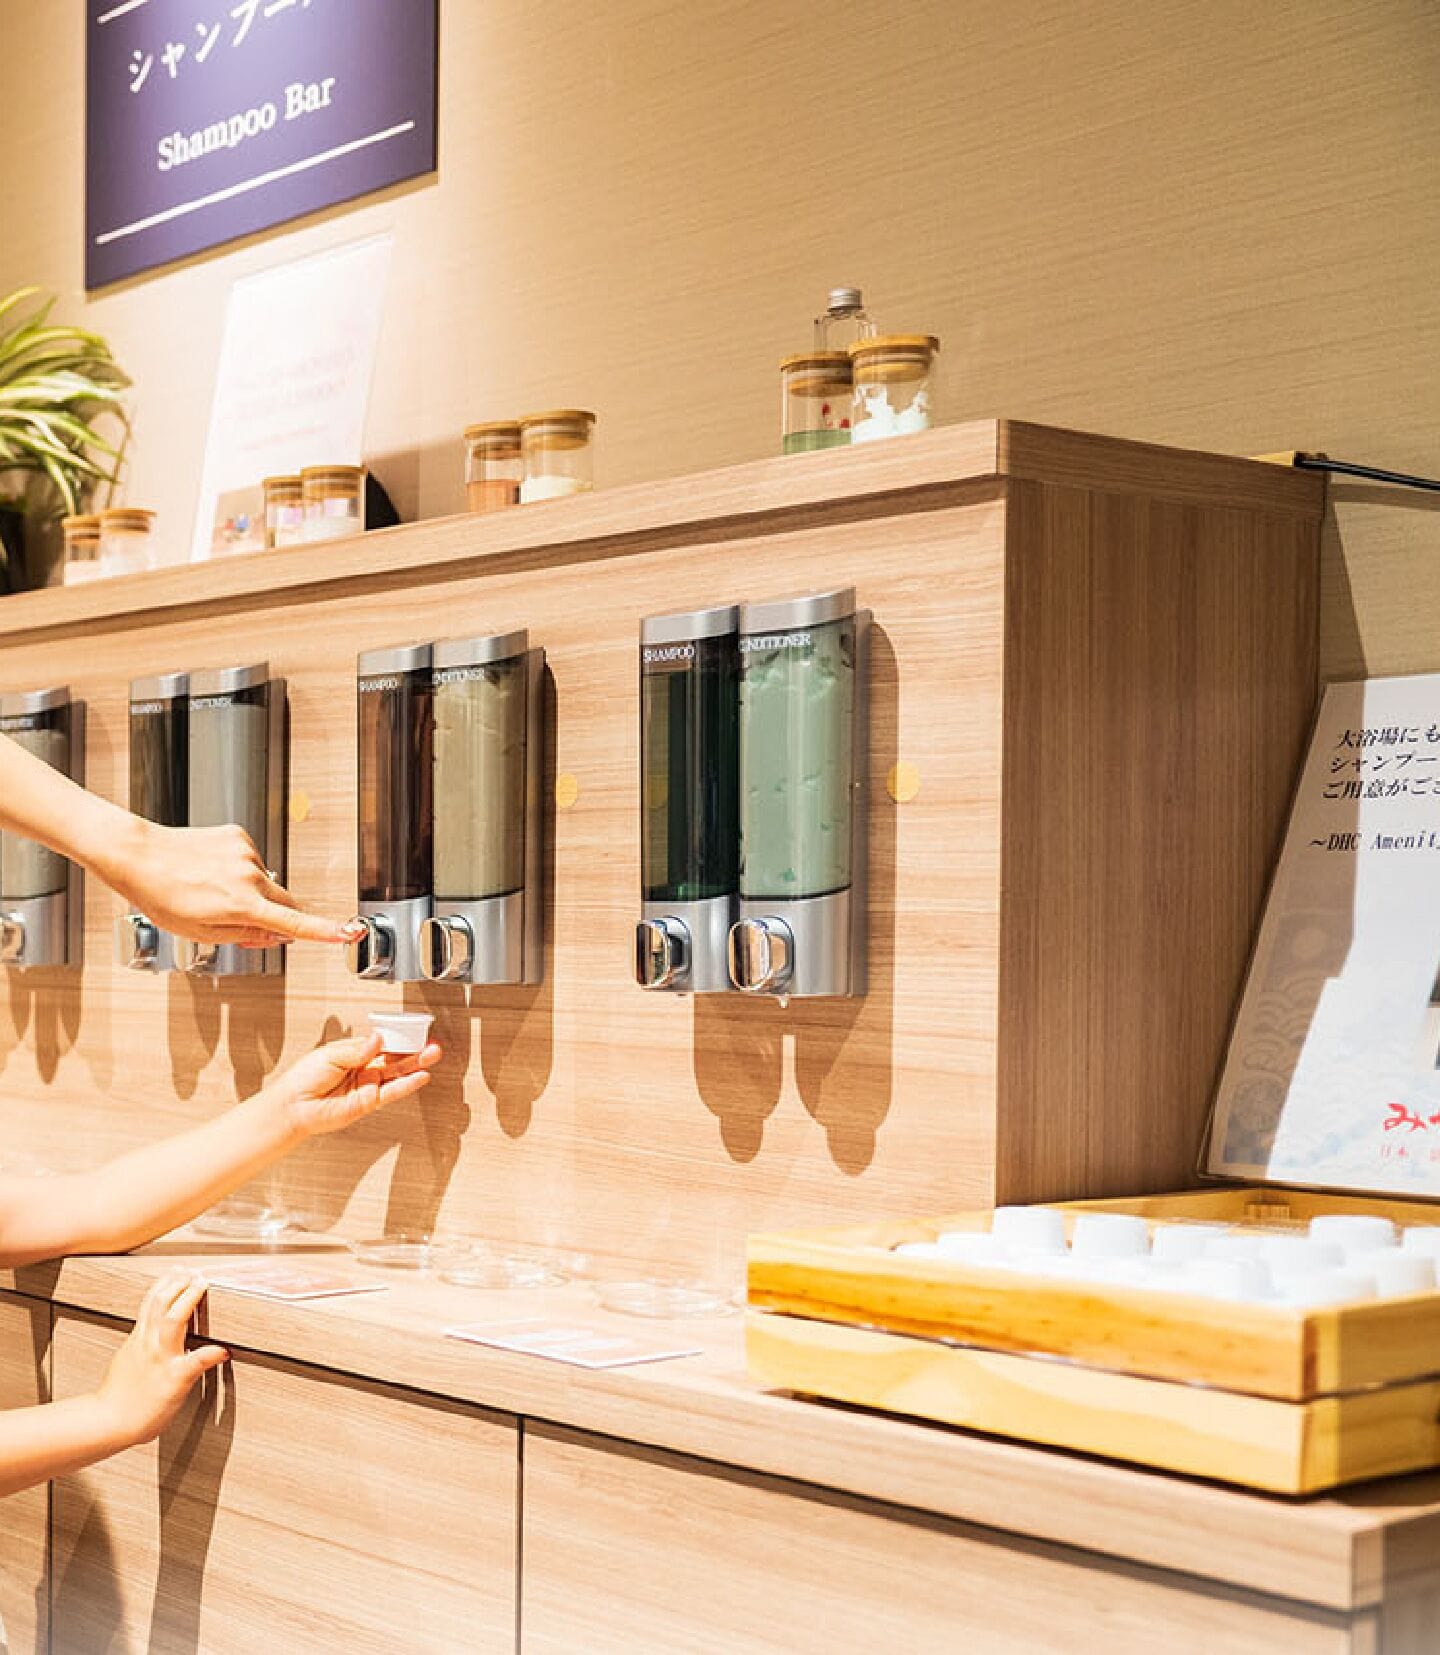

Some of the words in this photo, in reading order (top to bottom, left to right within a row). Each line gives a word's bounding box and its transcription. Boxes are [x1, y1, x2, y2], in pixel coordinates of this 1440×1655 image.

[158, 103, 278, 171] Shampoo
[284, 77, 336, 121] Bar
[1370, 830, 1440, 851] Amenit
